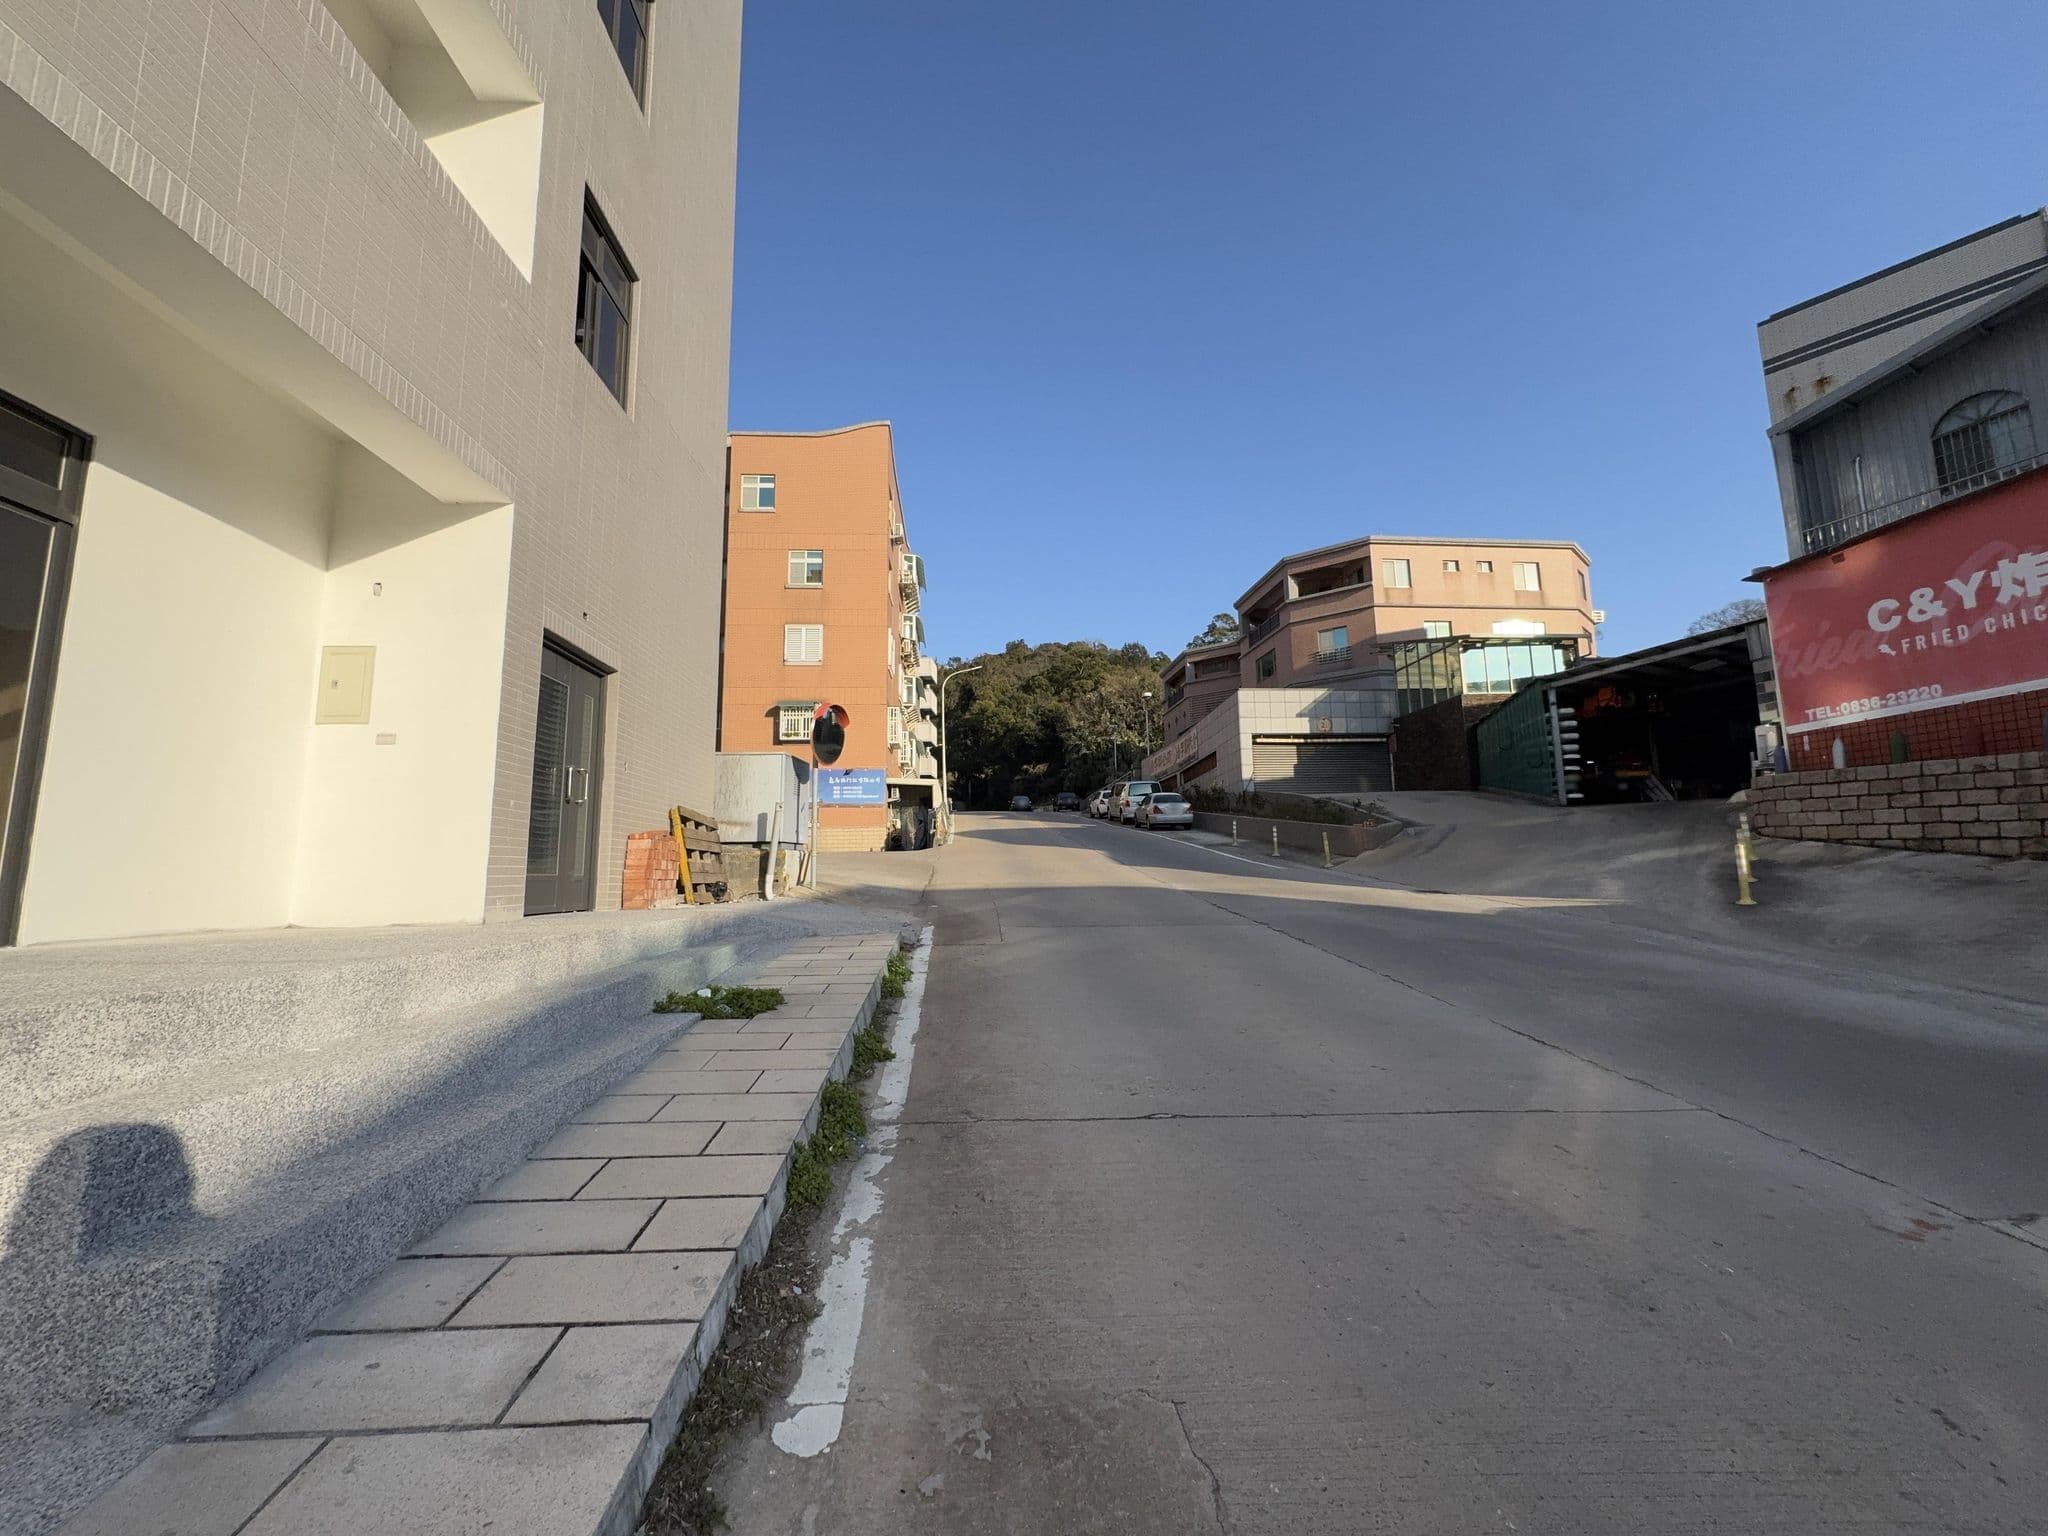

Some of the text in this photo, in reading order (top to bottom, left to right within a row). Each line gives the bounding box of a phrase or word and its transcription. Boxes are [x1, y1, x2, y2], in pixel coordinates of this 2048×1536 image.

[1901, 604, 2048, 655] FRIED CHIC
[1805, 684, 1942, 721] TEL:0836-23220
